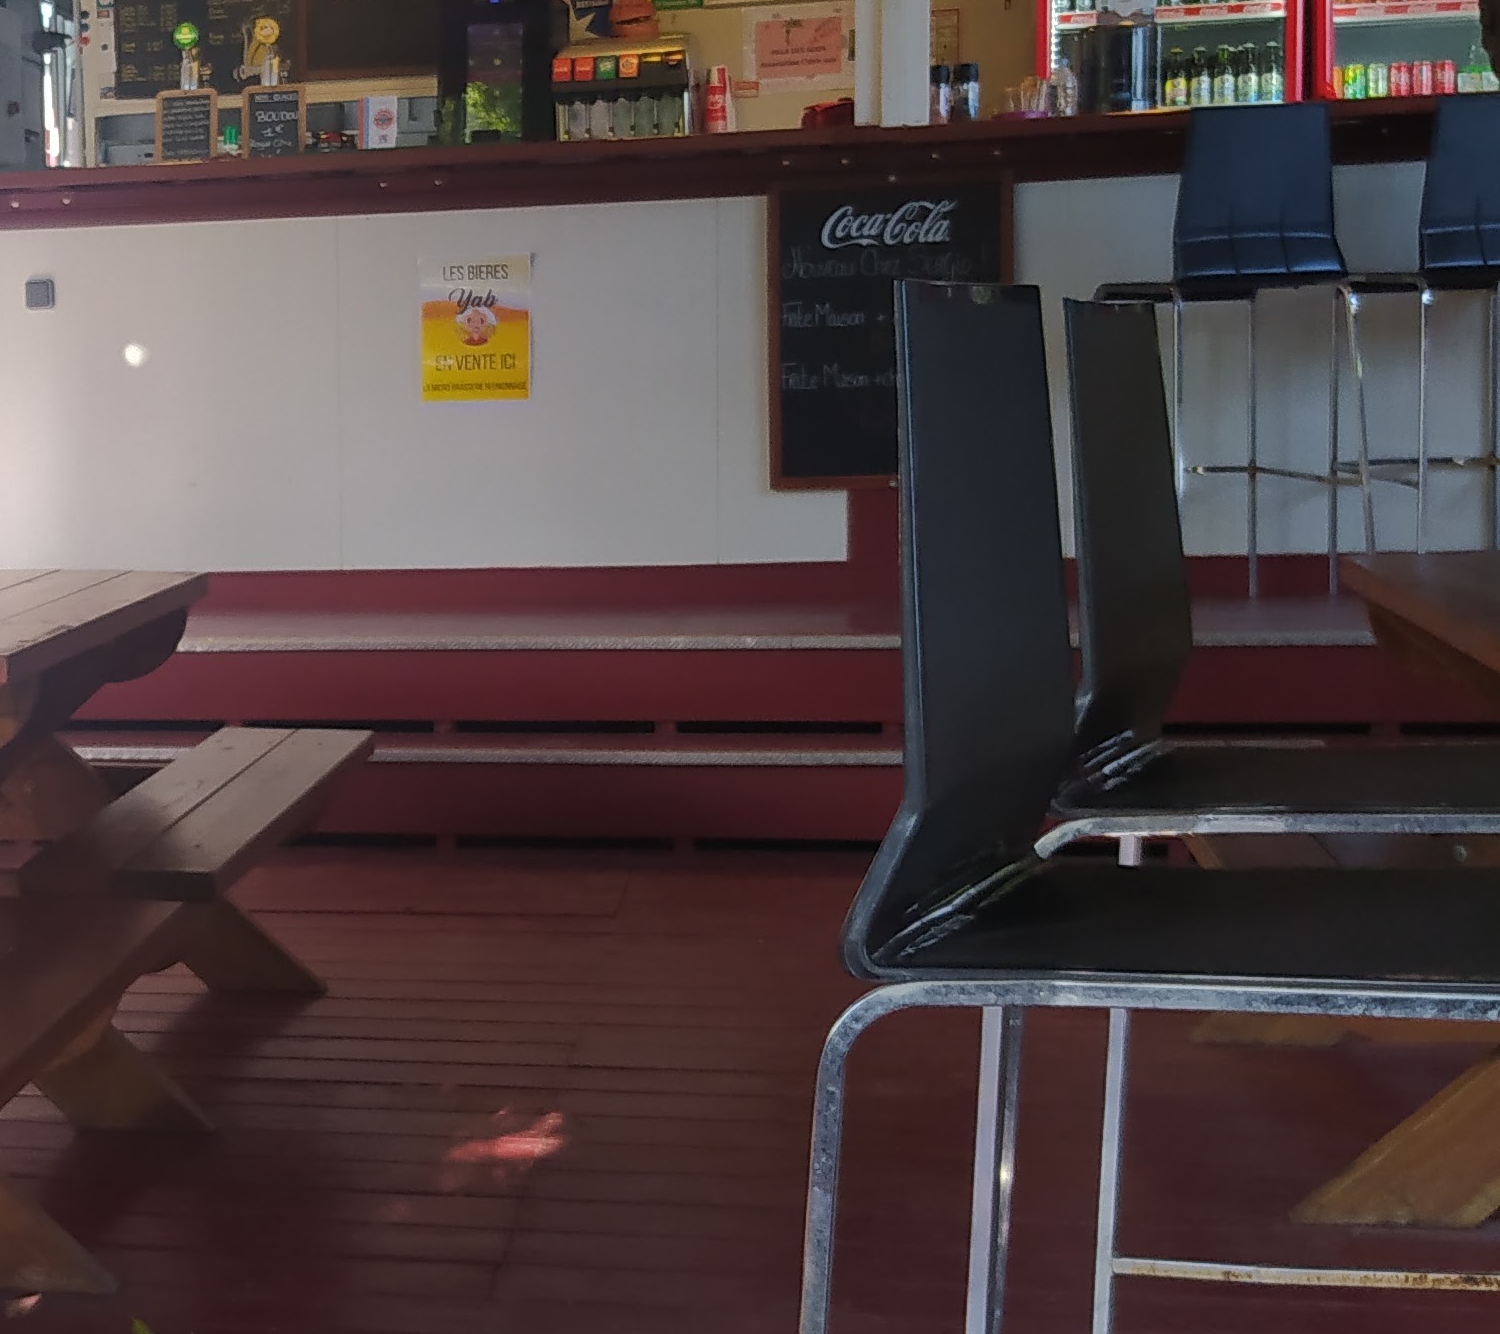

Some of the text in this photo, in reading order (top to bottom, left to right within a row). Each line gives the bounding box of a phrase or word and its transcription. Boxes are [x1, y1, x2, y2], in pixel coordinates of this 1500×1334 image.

[821, 200, 958, 249] Coca-Cola
[443, 264, 508, 281] LES BIERES
[448, 288, 498, 315] Yab
[435, 353, 516, 371] EN VENTE ICI
